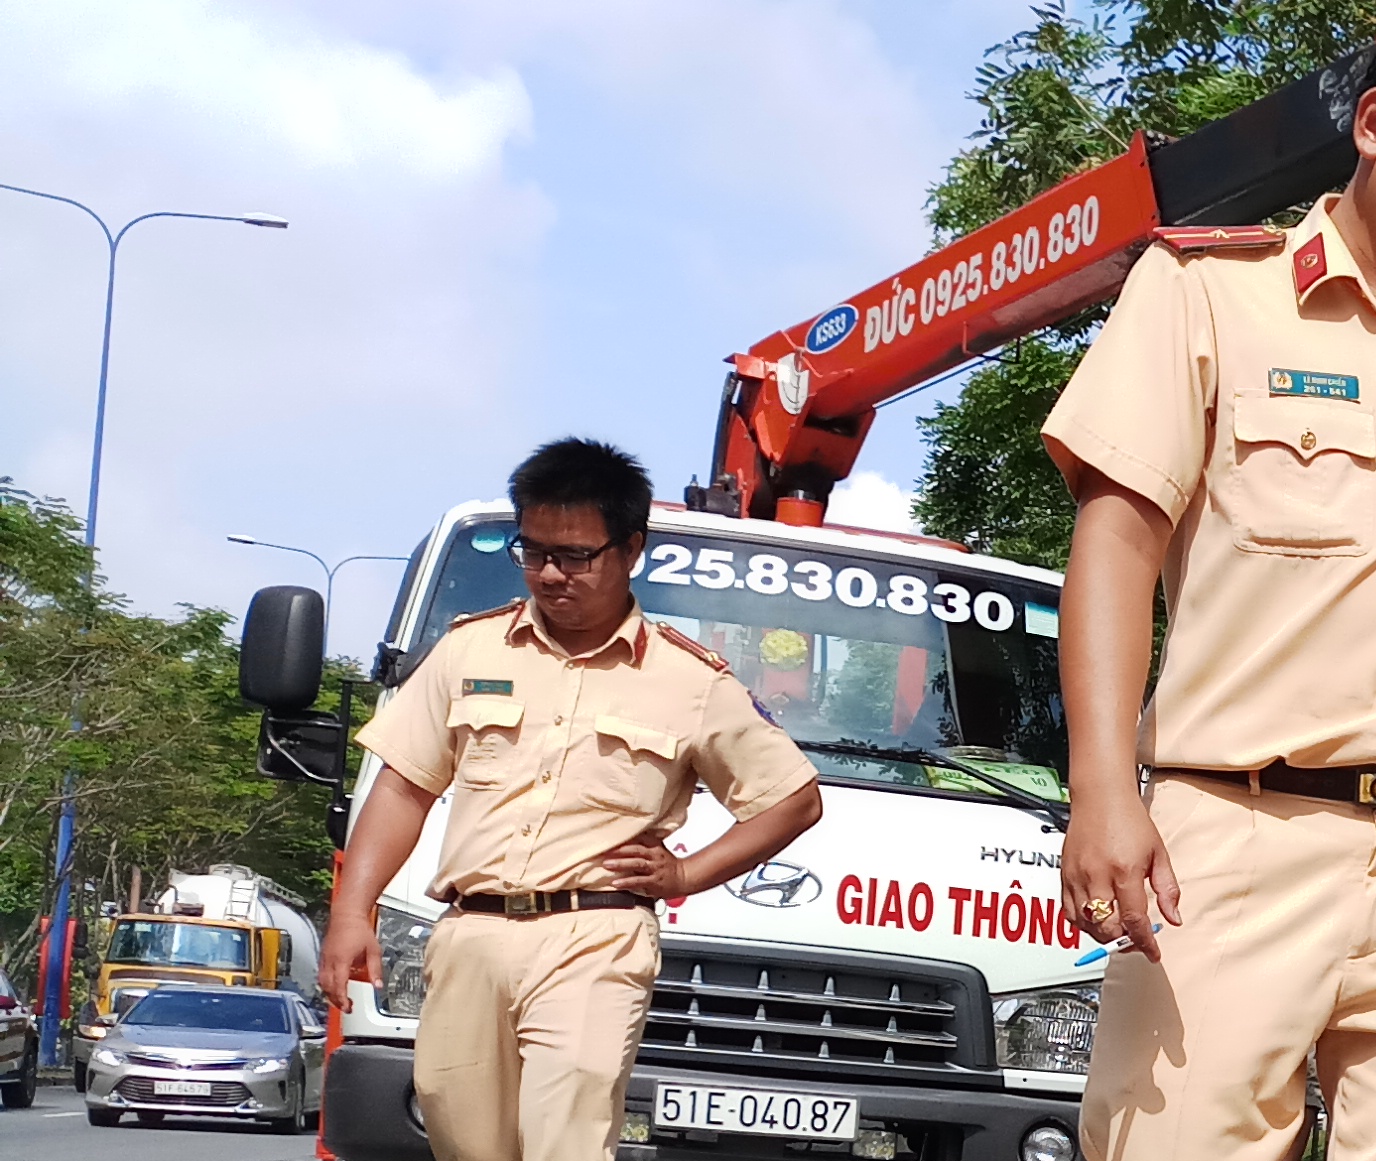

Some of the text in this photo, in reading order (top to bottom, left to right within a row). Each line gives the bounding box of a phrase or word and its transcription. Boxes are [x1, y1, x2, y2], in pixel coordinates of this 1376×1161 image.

[863, 195, 1099, 354] ĐỨC 0925.830.830
[629, 543, 1015, 632] 25.830.830
[980, 846, 1063, 869] HYUN
[836, 873, 1081, 950] GIAO THÔNG
[661, 1088, 851, 1134] 51E-040.87
